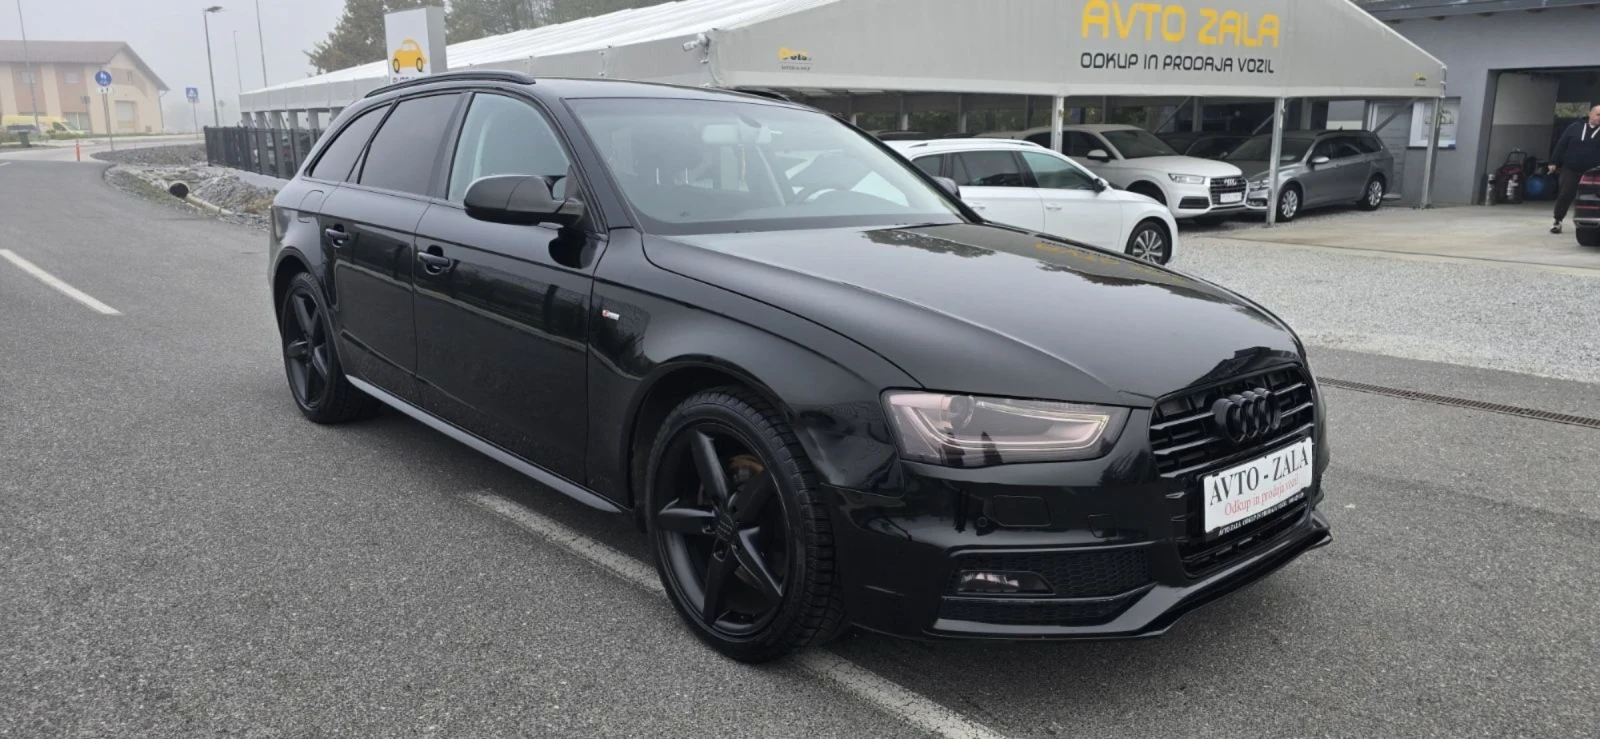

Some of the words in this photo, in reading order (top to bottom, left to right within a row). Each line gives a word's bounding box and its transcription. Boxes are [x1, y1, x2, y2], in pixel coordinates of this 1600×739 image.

[1081, 0, 1187, 42] AVTO
[1198, 8, 1280, 48] ZALA
[1080, 52, 1139, 69] ODKUP
[1143, 54, 1158, 70] IN
[1162, 55, 1233, 72] PRODAJA
[1237, 58, 1275, 74] VOZIL
[1210, 466, 1259, 506] AVTO
[1272, 445, 1309, 481] ZALA
[1224, 496, 1251, 516] Odkup
